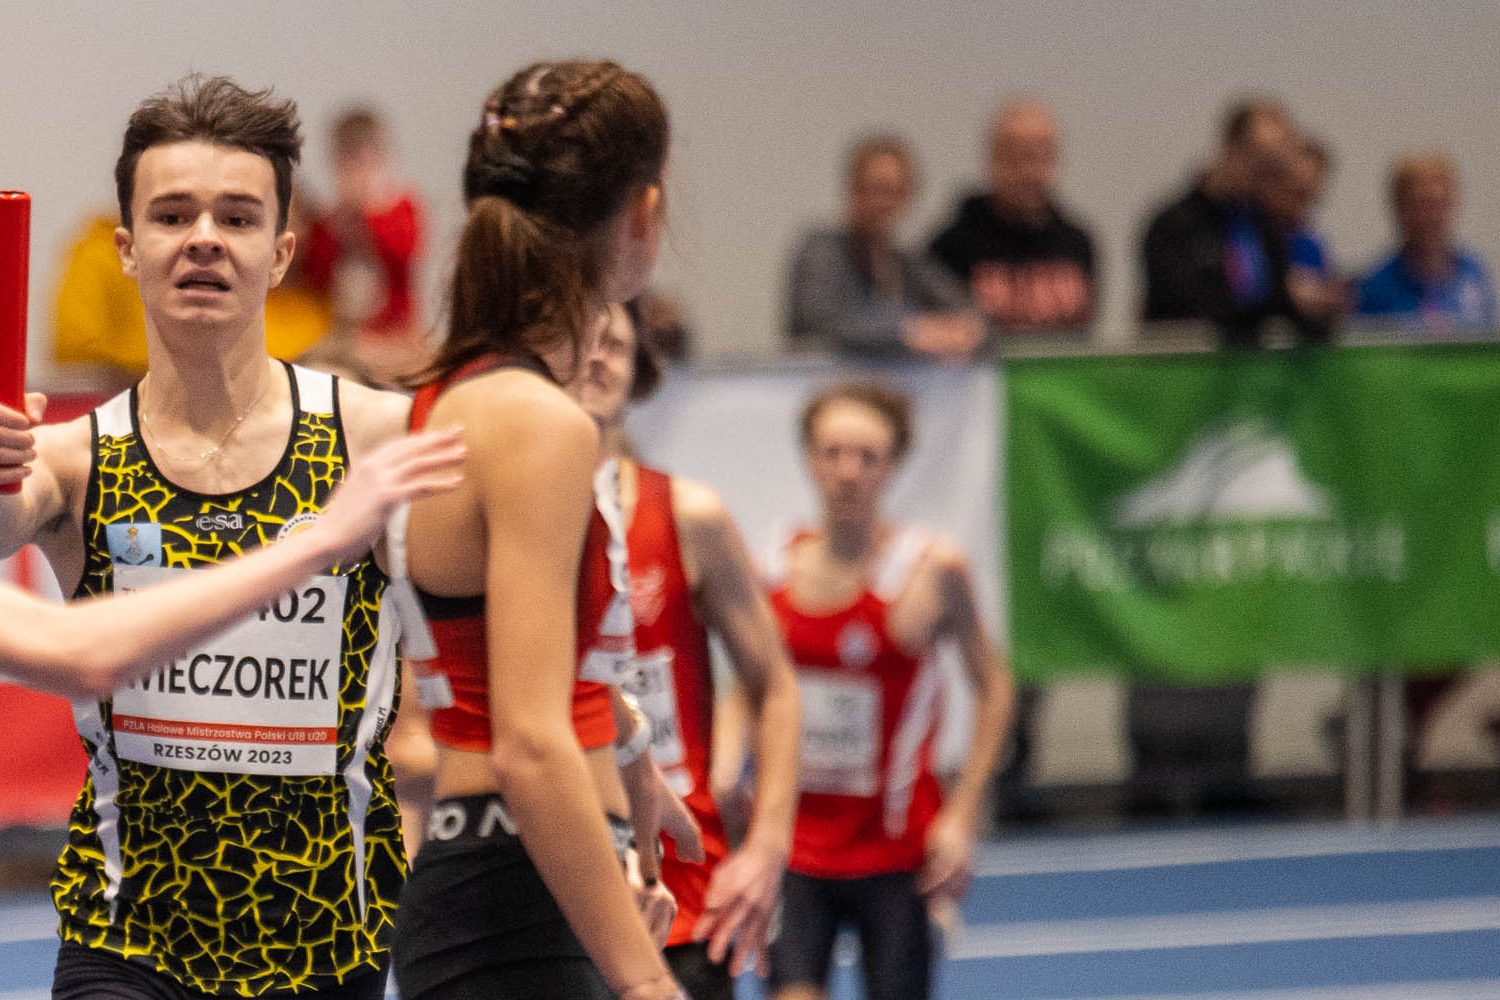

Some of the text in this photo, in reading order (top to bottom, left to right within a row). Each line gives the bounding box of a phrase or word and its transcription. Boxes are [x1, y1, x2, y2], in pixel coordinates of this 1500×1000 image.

[196, 513, 244, 531] esa
[128, 653, 331, 700] IECZOREK
[123, 719, 145, 731] PZLA
[186, 726, 252, 739] Mistrzostwa
[254, 730, 286, 741] Polski
[288, 731, 306, 741] U18
[153, 743, 293, 765] RZESZÓW 2023
